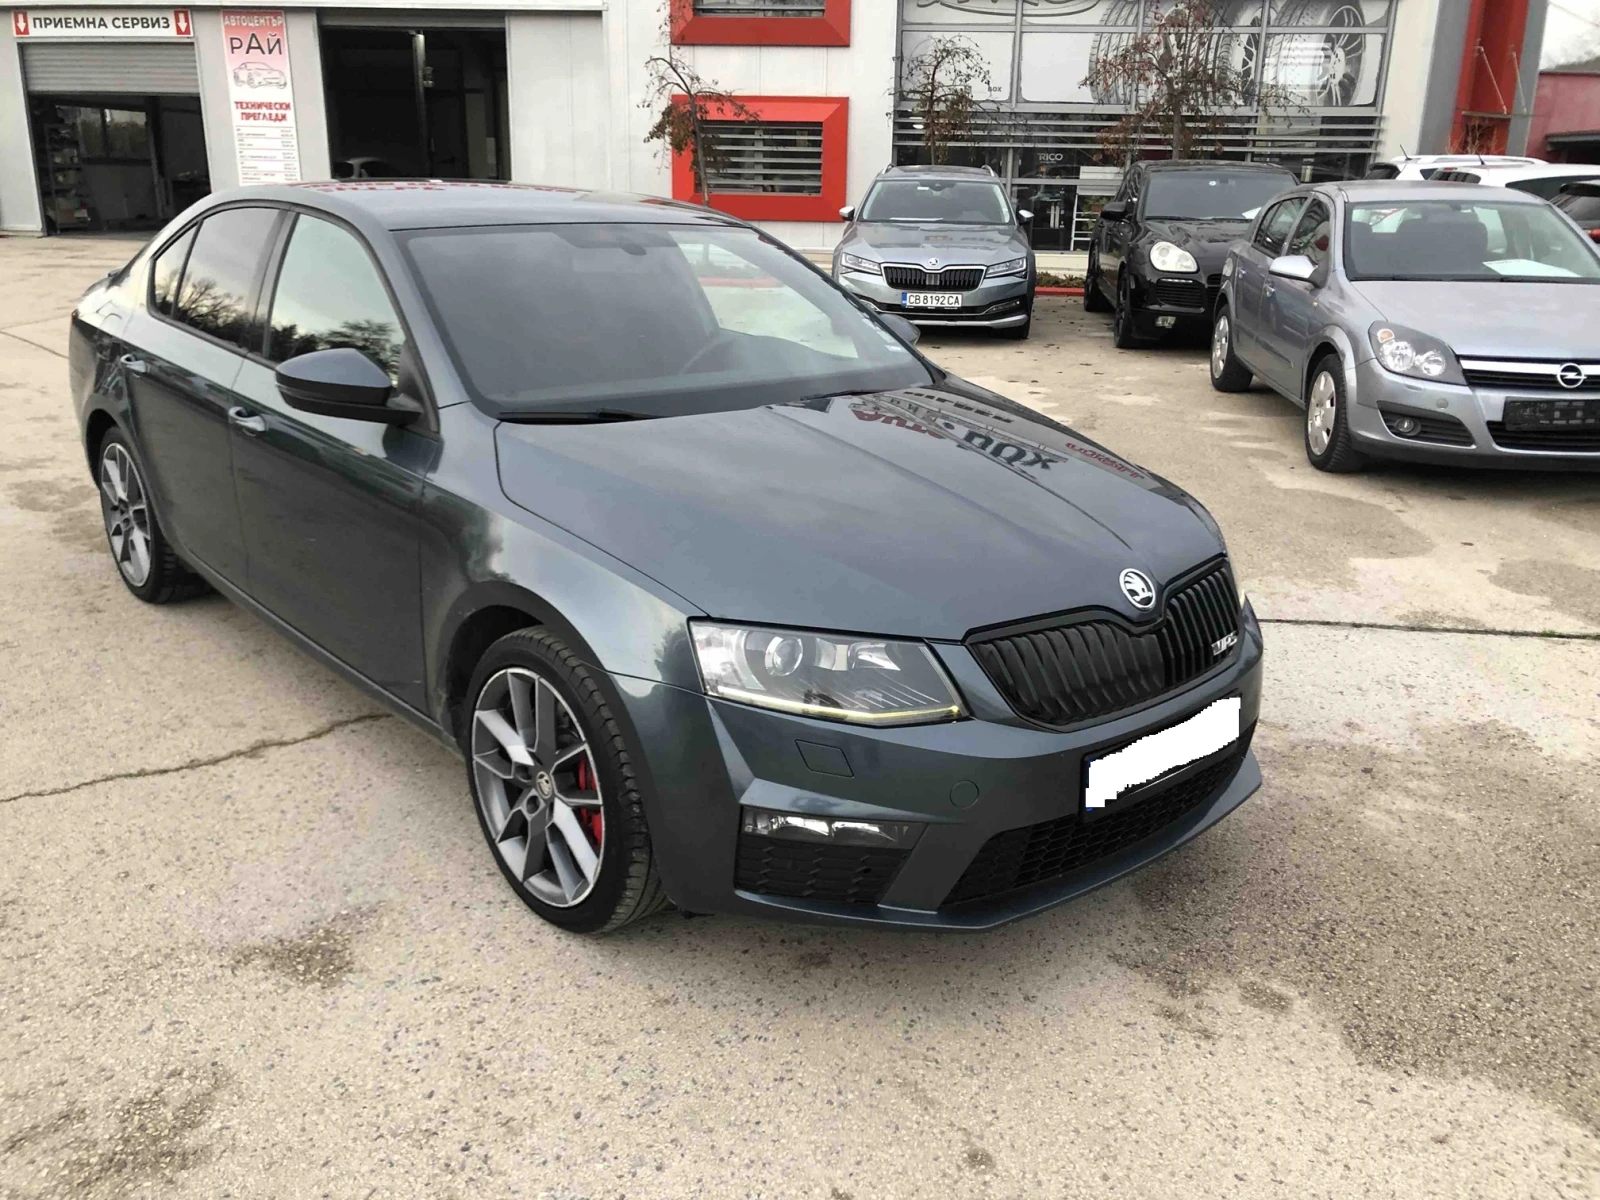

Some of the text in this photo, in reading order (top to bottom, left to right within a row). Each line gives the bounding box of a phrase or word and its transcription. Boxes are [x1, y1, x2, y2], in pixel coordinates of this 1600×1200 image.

[32, 16, 170, 29] ПРИЕМНА СЕРВИЗ
[229, 32, 283, 55] РАЙ
[234, 101, 291, 111] ТЕХНИЧЕСКИ
[241, 111, 287, 123] ПРЕГЛЕДИ
[908, 294, 960, 306] CB 8192 CA
